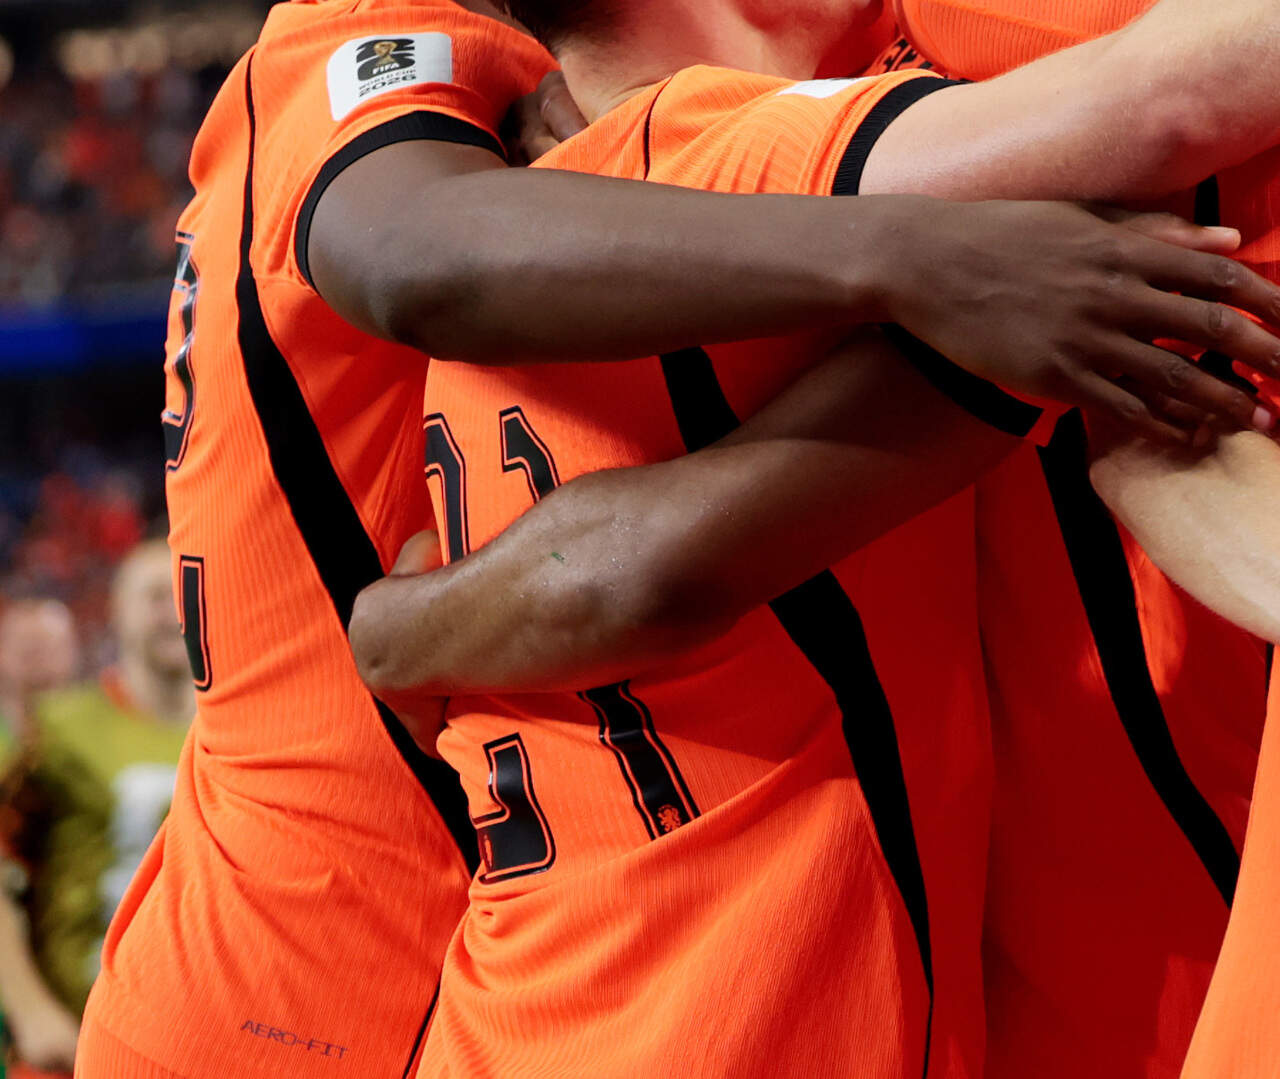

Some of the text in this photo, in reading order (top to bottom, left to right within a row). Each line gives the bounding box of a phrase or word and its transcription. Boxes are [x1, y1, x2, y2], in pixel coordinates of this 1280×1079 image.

[372, 62, 400, 75] FIFA
[359, 74, 417, 98] 2026
[240, 1019, 348, 1060] AERO-FIT
